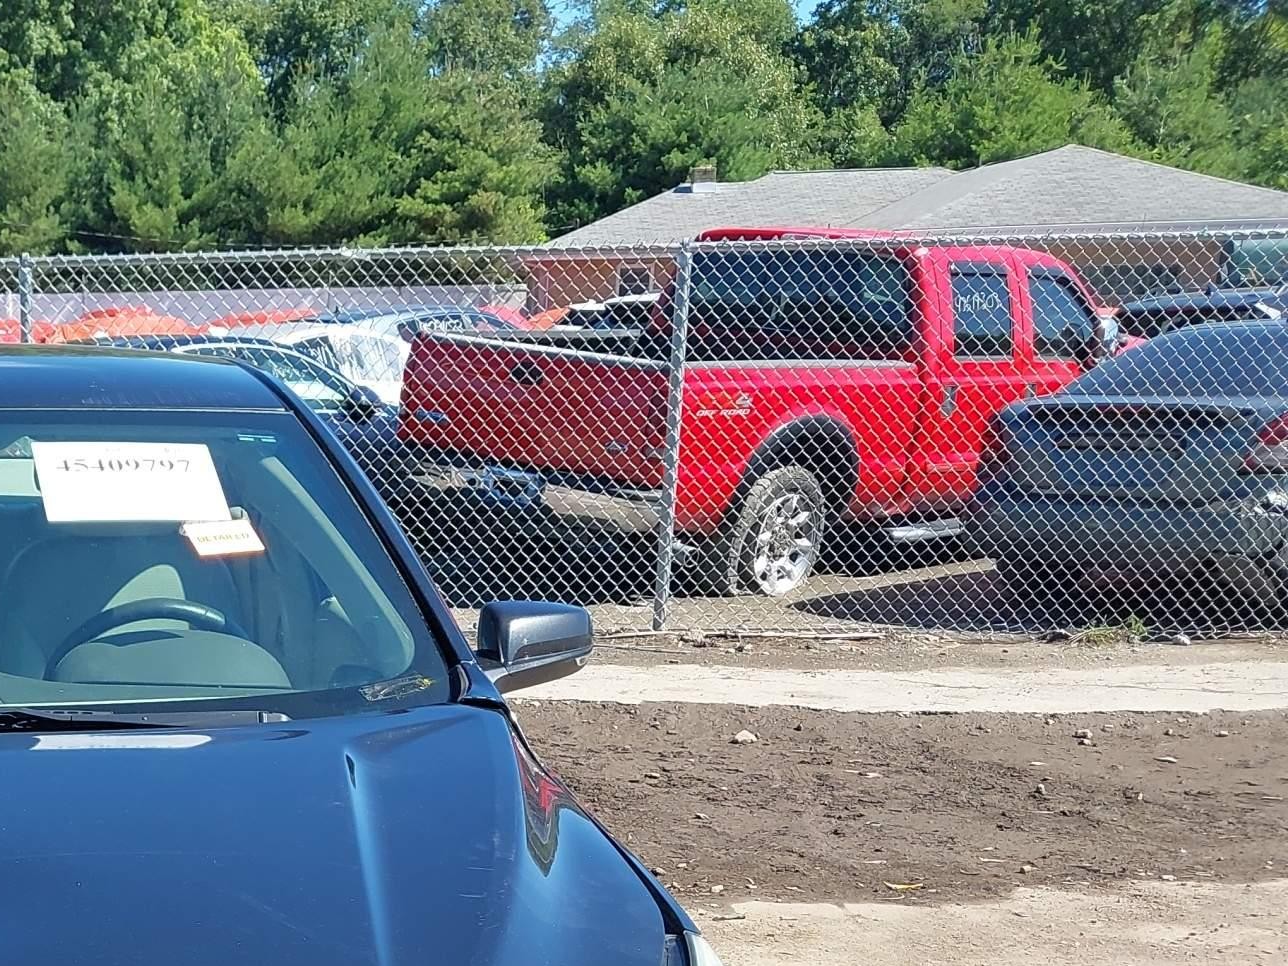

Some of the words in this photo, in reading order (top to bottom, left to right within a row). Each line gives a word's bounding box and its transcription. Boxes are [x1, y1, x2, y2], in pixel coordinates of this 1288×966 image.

[696, 409, 719, 417] OFF
[719, 408, 751, 416] ROAD
[55, 457, 192, 473] 45409797
